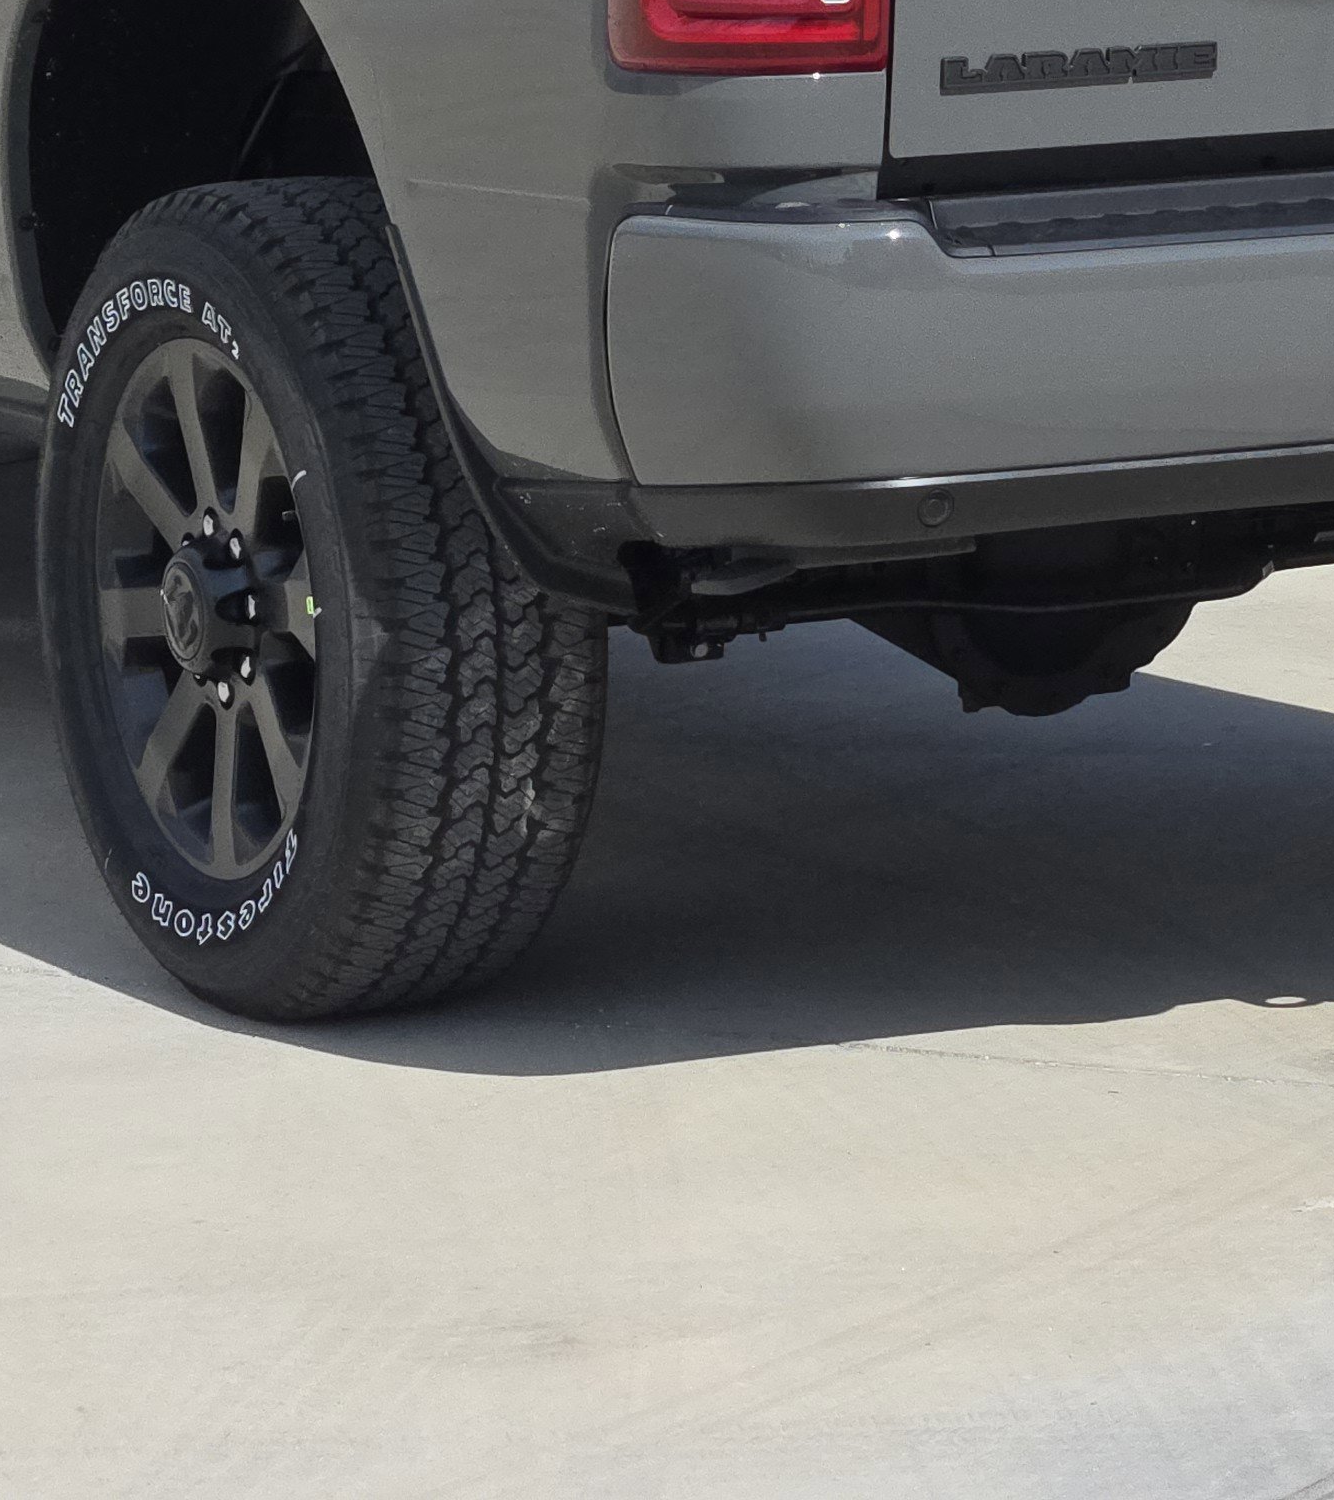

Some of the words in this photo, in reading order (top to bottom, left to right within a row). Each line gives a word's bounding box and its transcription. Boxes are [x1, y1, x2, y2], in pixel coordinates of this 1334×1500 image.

[940, 41, 1217, 96] LARAMIE
[57, 279, 193, 428] TRANSFORCE
[131, 827, 298, 946] Firestone
